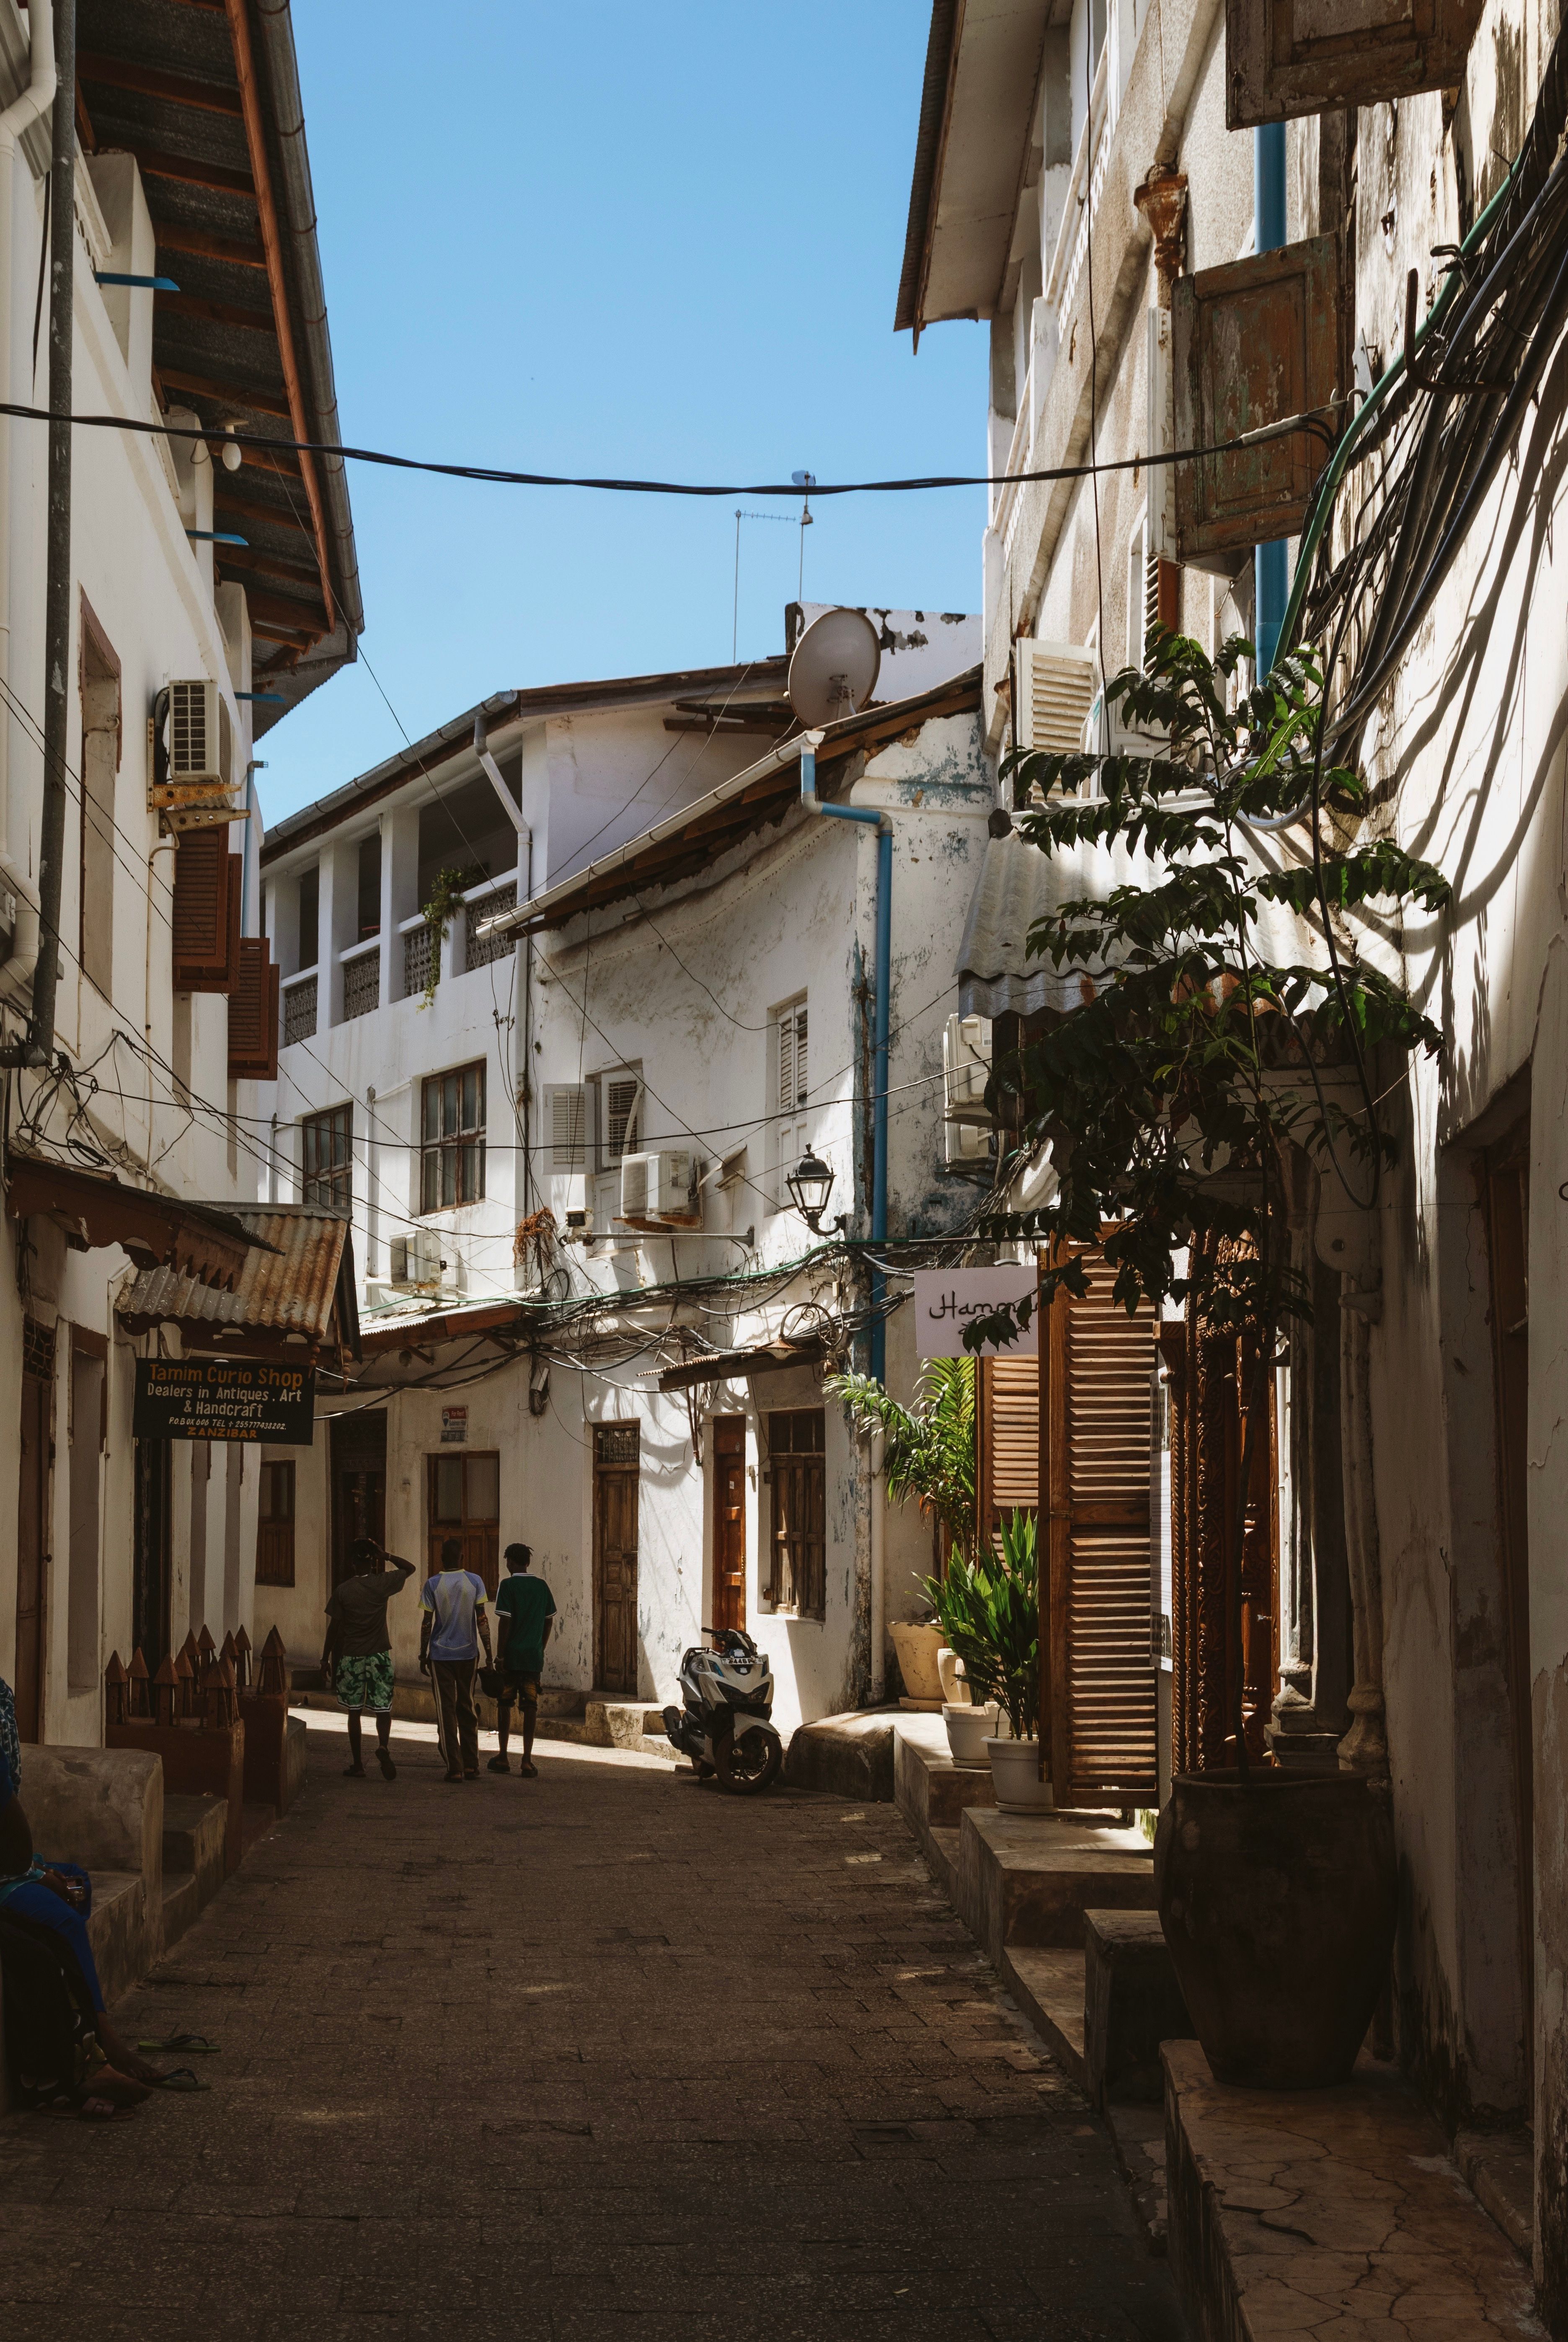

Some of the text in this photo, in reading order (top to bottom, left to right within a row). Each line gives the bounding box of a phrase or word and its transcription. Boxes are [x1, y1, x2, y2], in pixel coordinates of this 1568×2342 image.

[929, 1290, 1038, 1319] Hamm
[150, 1364, 303, 1390] Tamim Curio Shop
[147, 1382, 192, 1397] Dealers
[198, 1386, 209, 1398] in
[279, 1389, 301, 1402] Art
[183, 1400, 263, 1417] & Handcraft
[212, 1419, 225, 1427] TEL
[187, 1427, 257, 1438] ZANZIBAR
